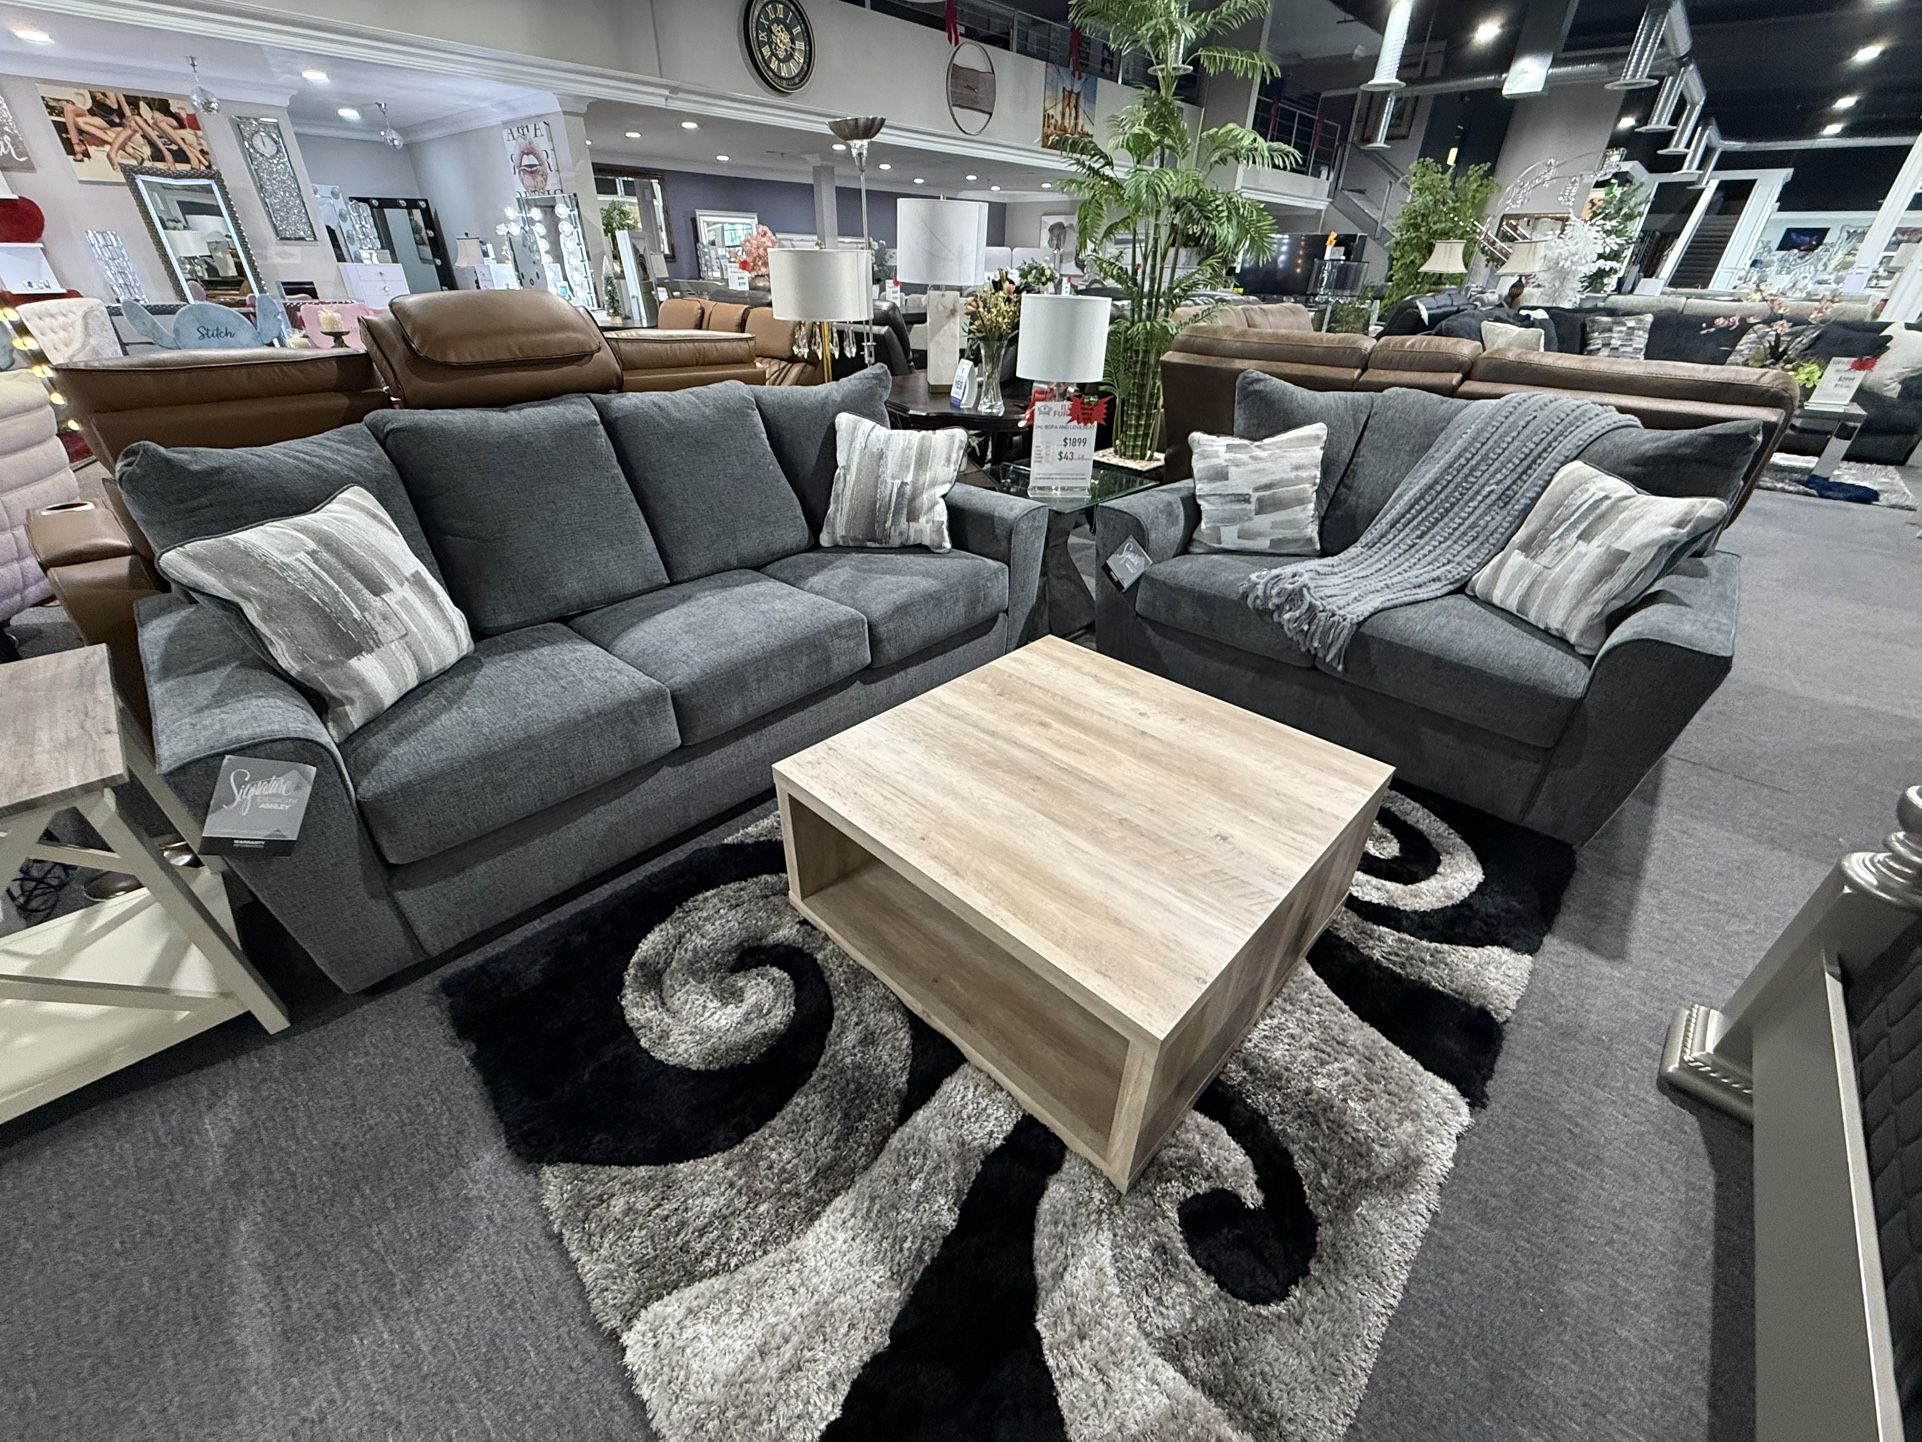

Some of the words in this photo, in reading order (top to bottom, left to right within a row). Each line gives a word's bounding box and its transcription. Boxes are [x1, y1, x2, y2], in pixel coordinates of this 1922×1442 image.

[196, 325, 236, 341] Stitch
[1063, 437, 1088, 448] $1899
[1058, 451, 1075, 462] $43
